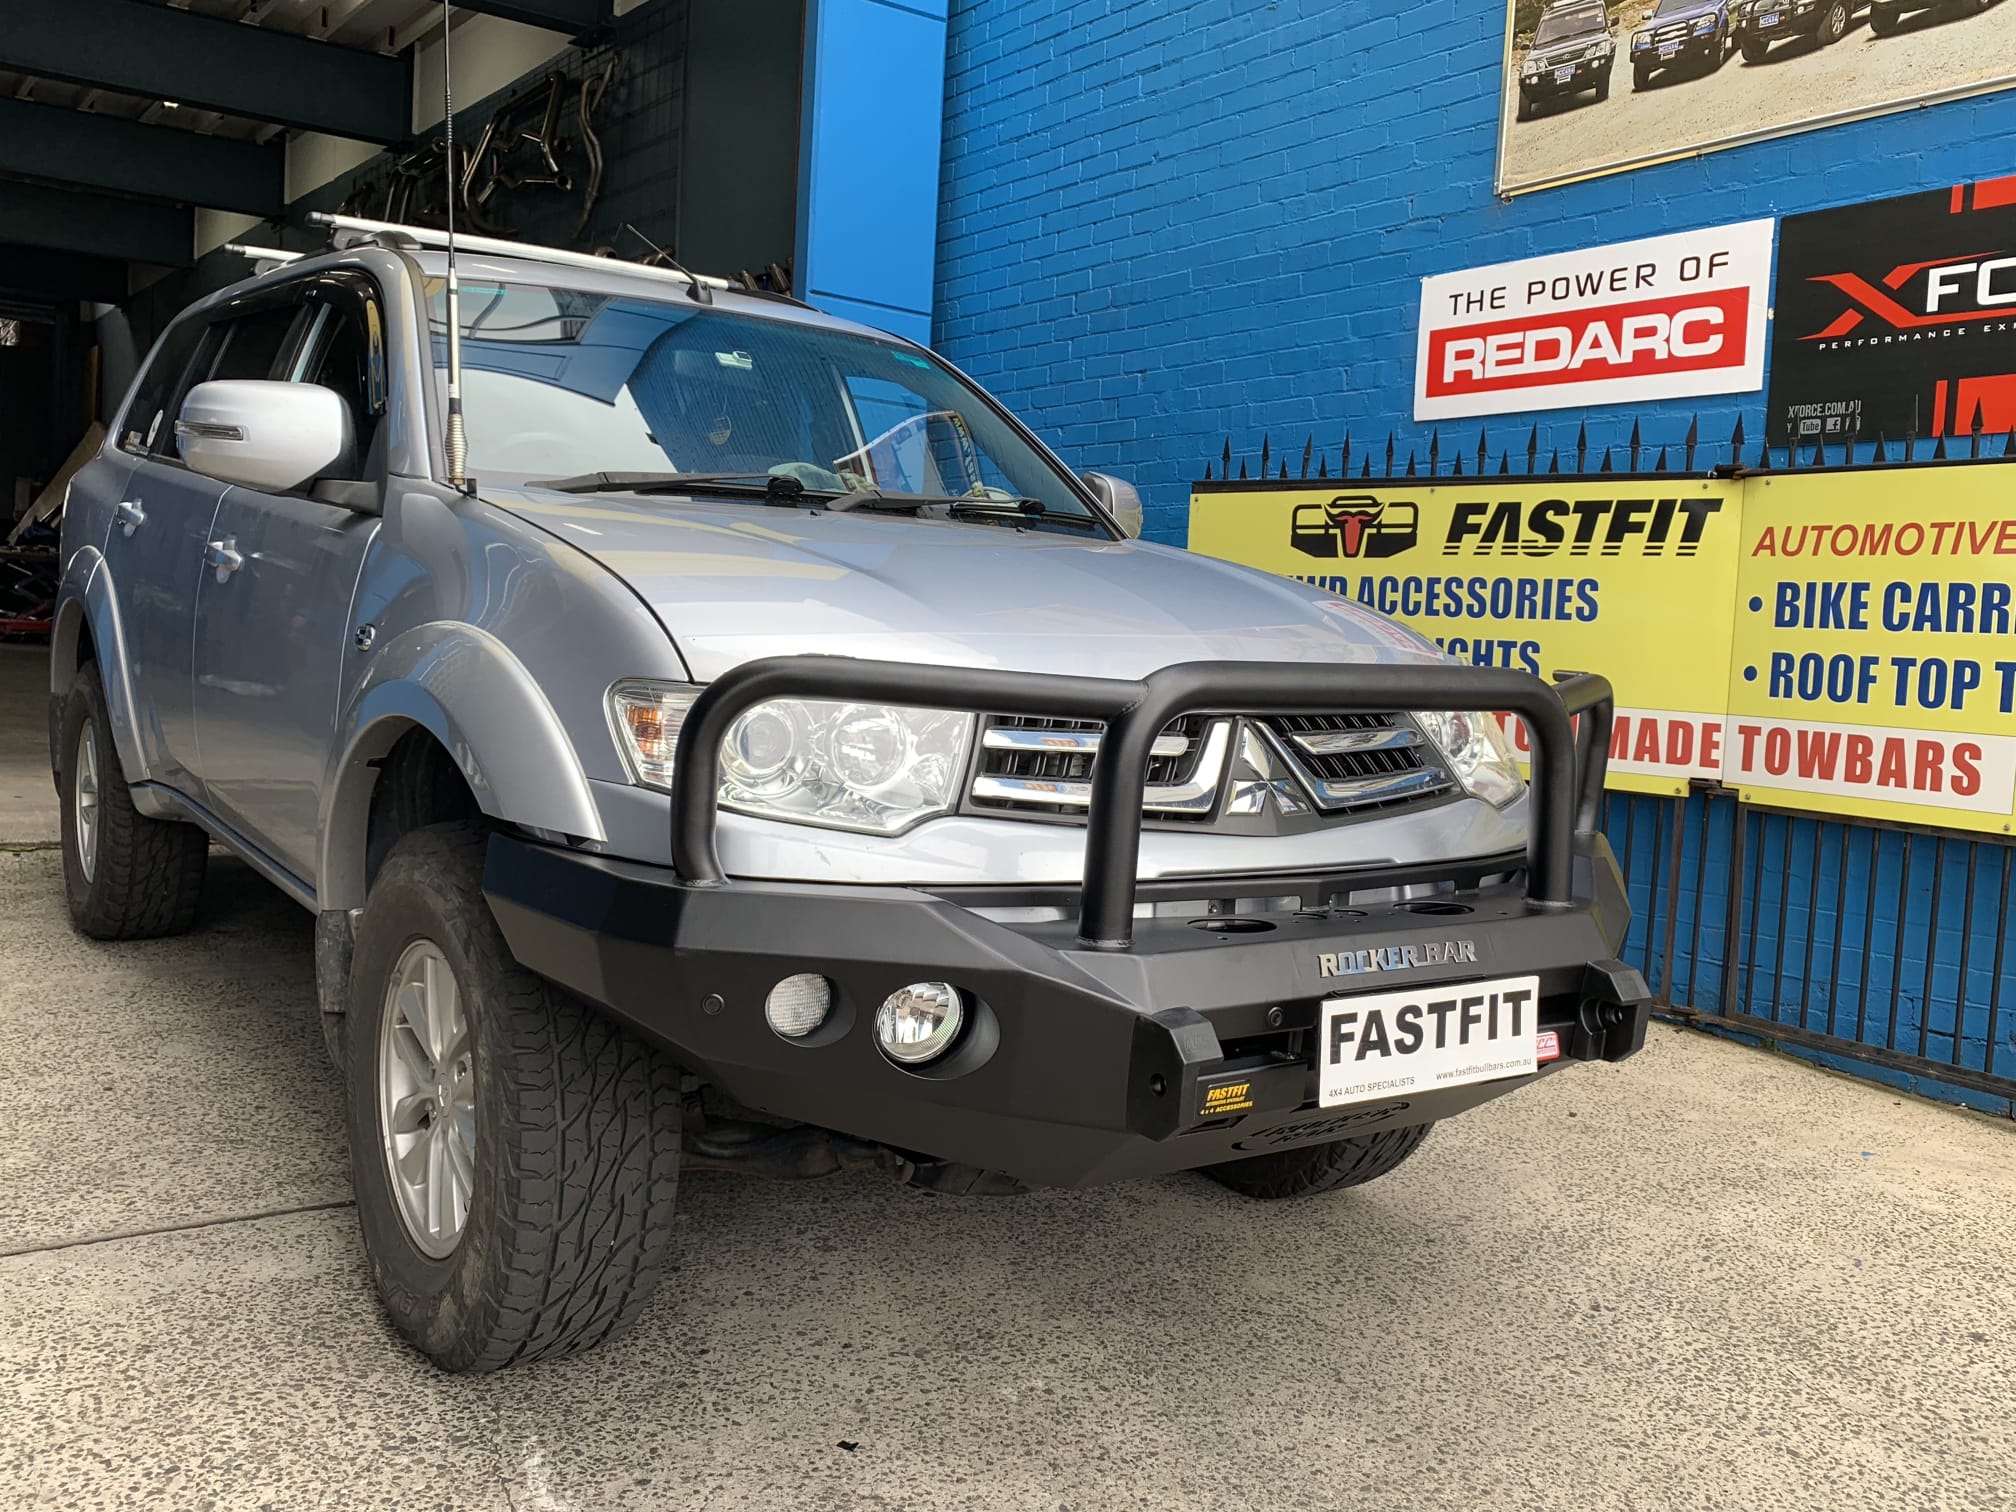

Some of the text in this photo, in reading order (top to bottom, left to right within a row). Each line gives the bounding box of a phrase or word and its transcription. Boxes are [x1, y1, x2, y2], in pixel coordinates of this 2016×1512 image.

[1449, 251, 1729, 316] THE POWER OF
[1443, 306, 1724, 383] REDARC
[1819, 327, 1966, 350] PERFORMANCE
[1443, 498, 1724, 557] FASTFIT
[1751, 521, 2016, 557] AUTOMOTIVE
[1356, 575, 1599, 622] ACCESSORIES
[1774, 581, 2016, 635] BIKE CARR
[1768, 651, 1880, 704] ROOF
[1891, 657, 1981, 710] TOP
[1608, 716, 1722, 769] MADE
[1738, 724, 1983, 797] TOWBARS
[1319, 940, 1478, 977] ROCKER BAR
[1329, 989, 1532, 1065] FASTFIT
[1207, 1083, 1250, 1101] FASTFIT
[1329, 1076, 1415, 1098] 4X4 AUTO SPECIALISTS
